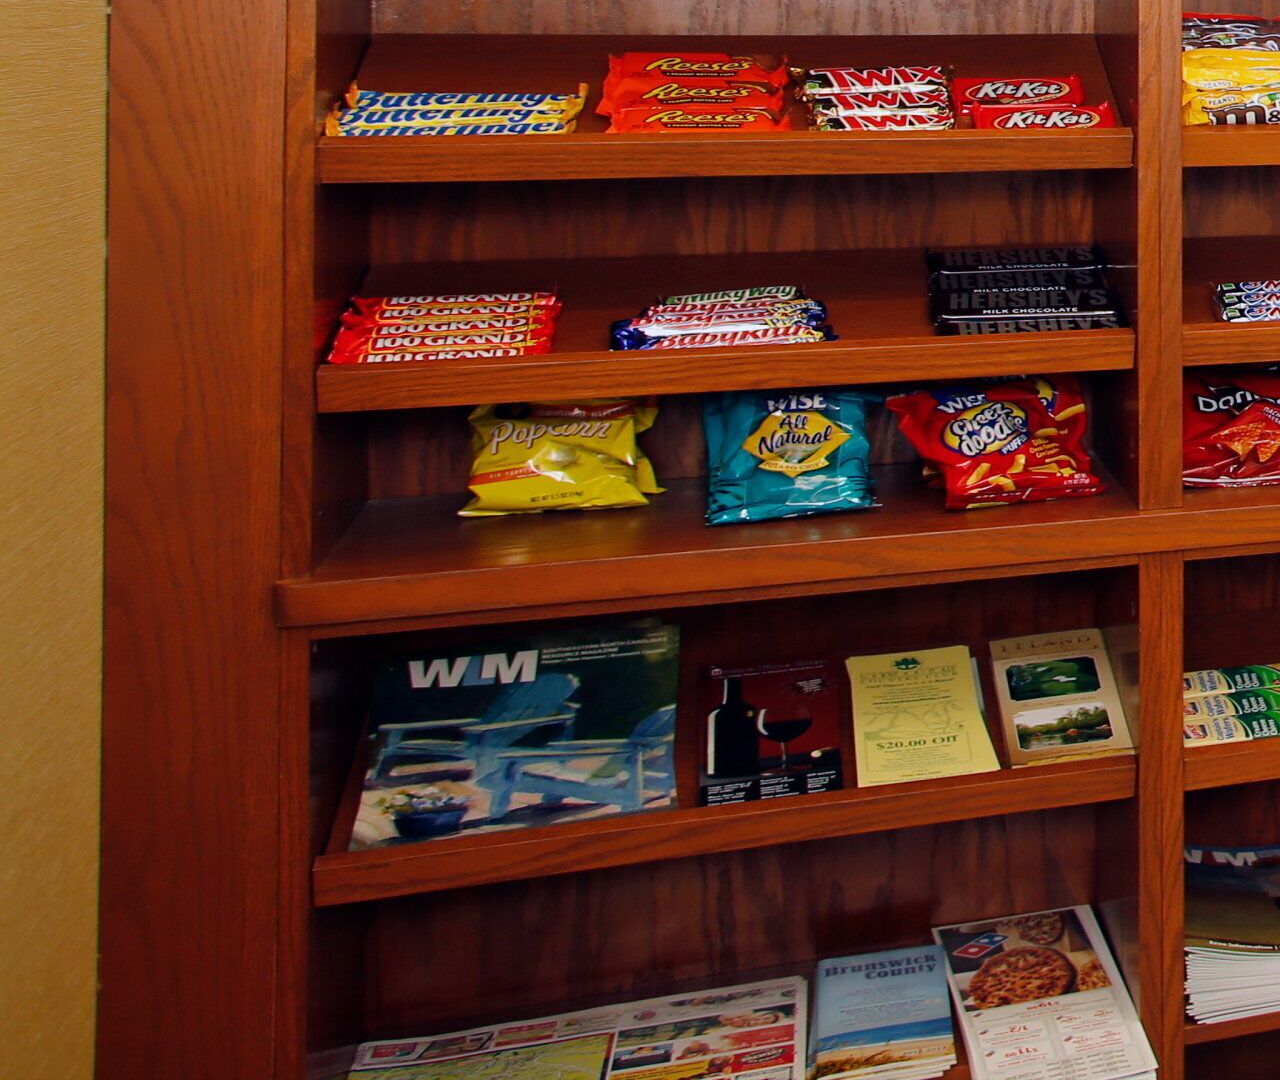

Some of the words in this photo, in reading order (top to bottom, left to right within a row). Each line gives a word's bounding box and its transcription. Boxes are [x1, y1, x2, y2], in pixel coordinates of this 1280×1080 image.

[809, 66, 947, 92] TWIX
[817, 90, 949, 111] TWIX
[390, 295, 434, 305] 100
[436, 293, 532, 302] GRAND
[949, 289, 1108, 310] HERSHEY'S
[379, 322, 424, 335] 100
[426, 318, 527, 332] GRAND
[375, 336, 421, 348] 100
[424, 333, 525, 346] GRAND
[767, 393, 828, 413] WISE
[937, 394, 987, 414] WISE
[780, 415, 809, 430] All
[951, 403, 1013, 437] Cheez
[490, 421, 612, 456] Popcorn
[758, 424, 833, 455] Natural
[409, 649, 540, 689] WLM
[875, 738, 927, 751] $20.00
[932, 735, 959, 745] Off
[824, 952, 937, 978] Brunswick
